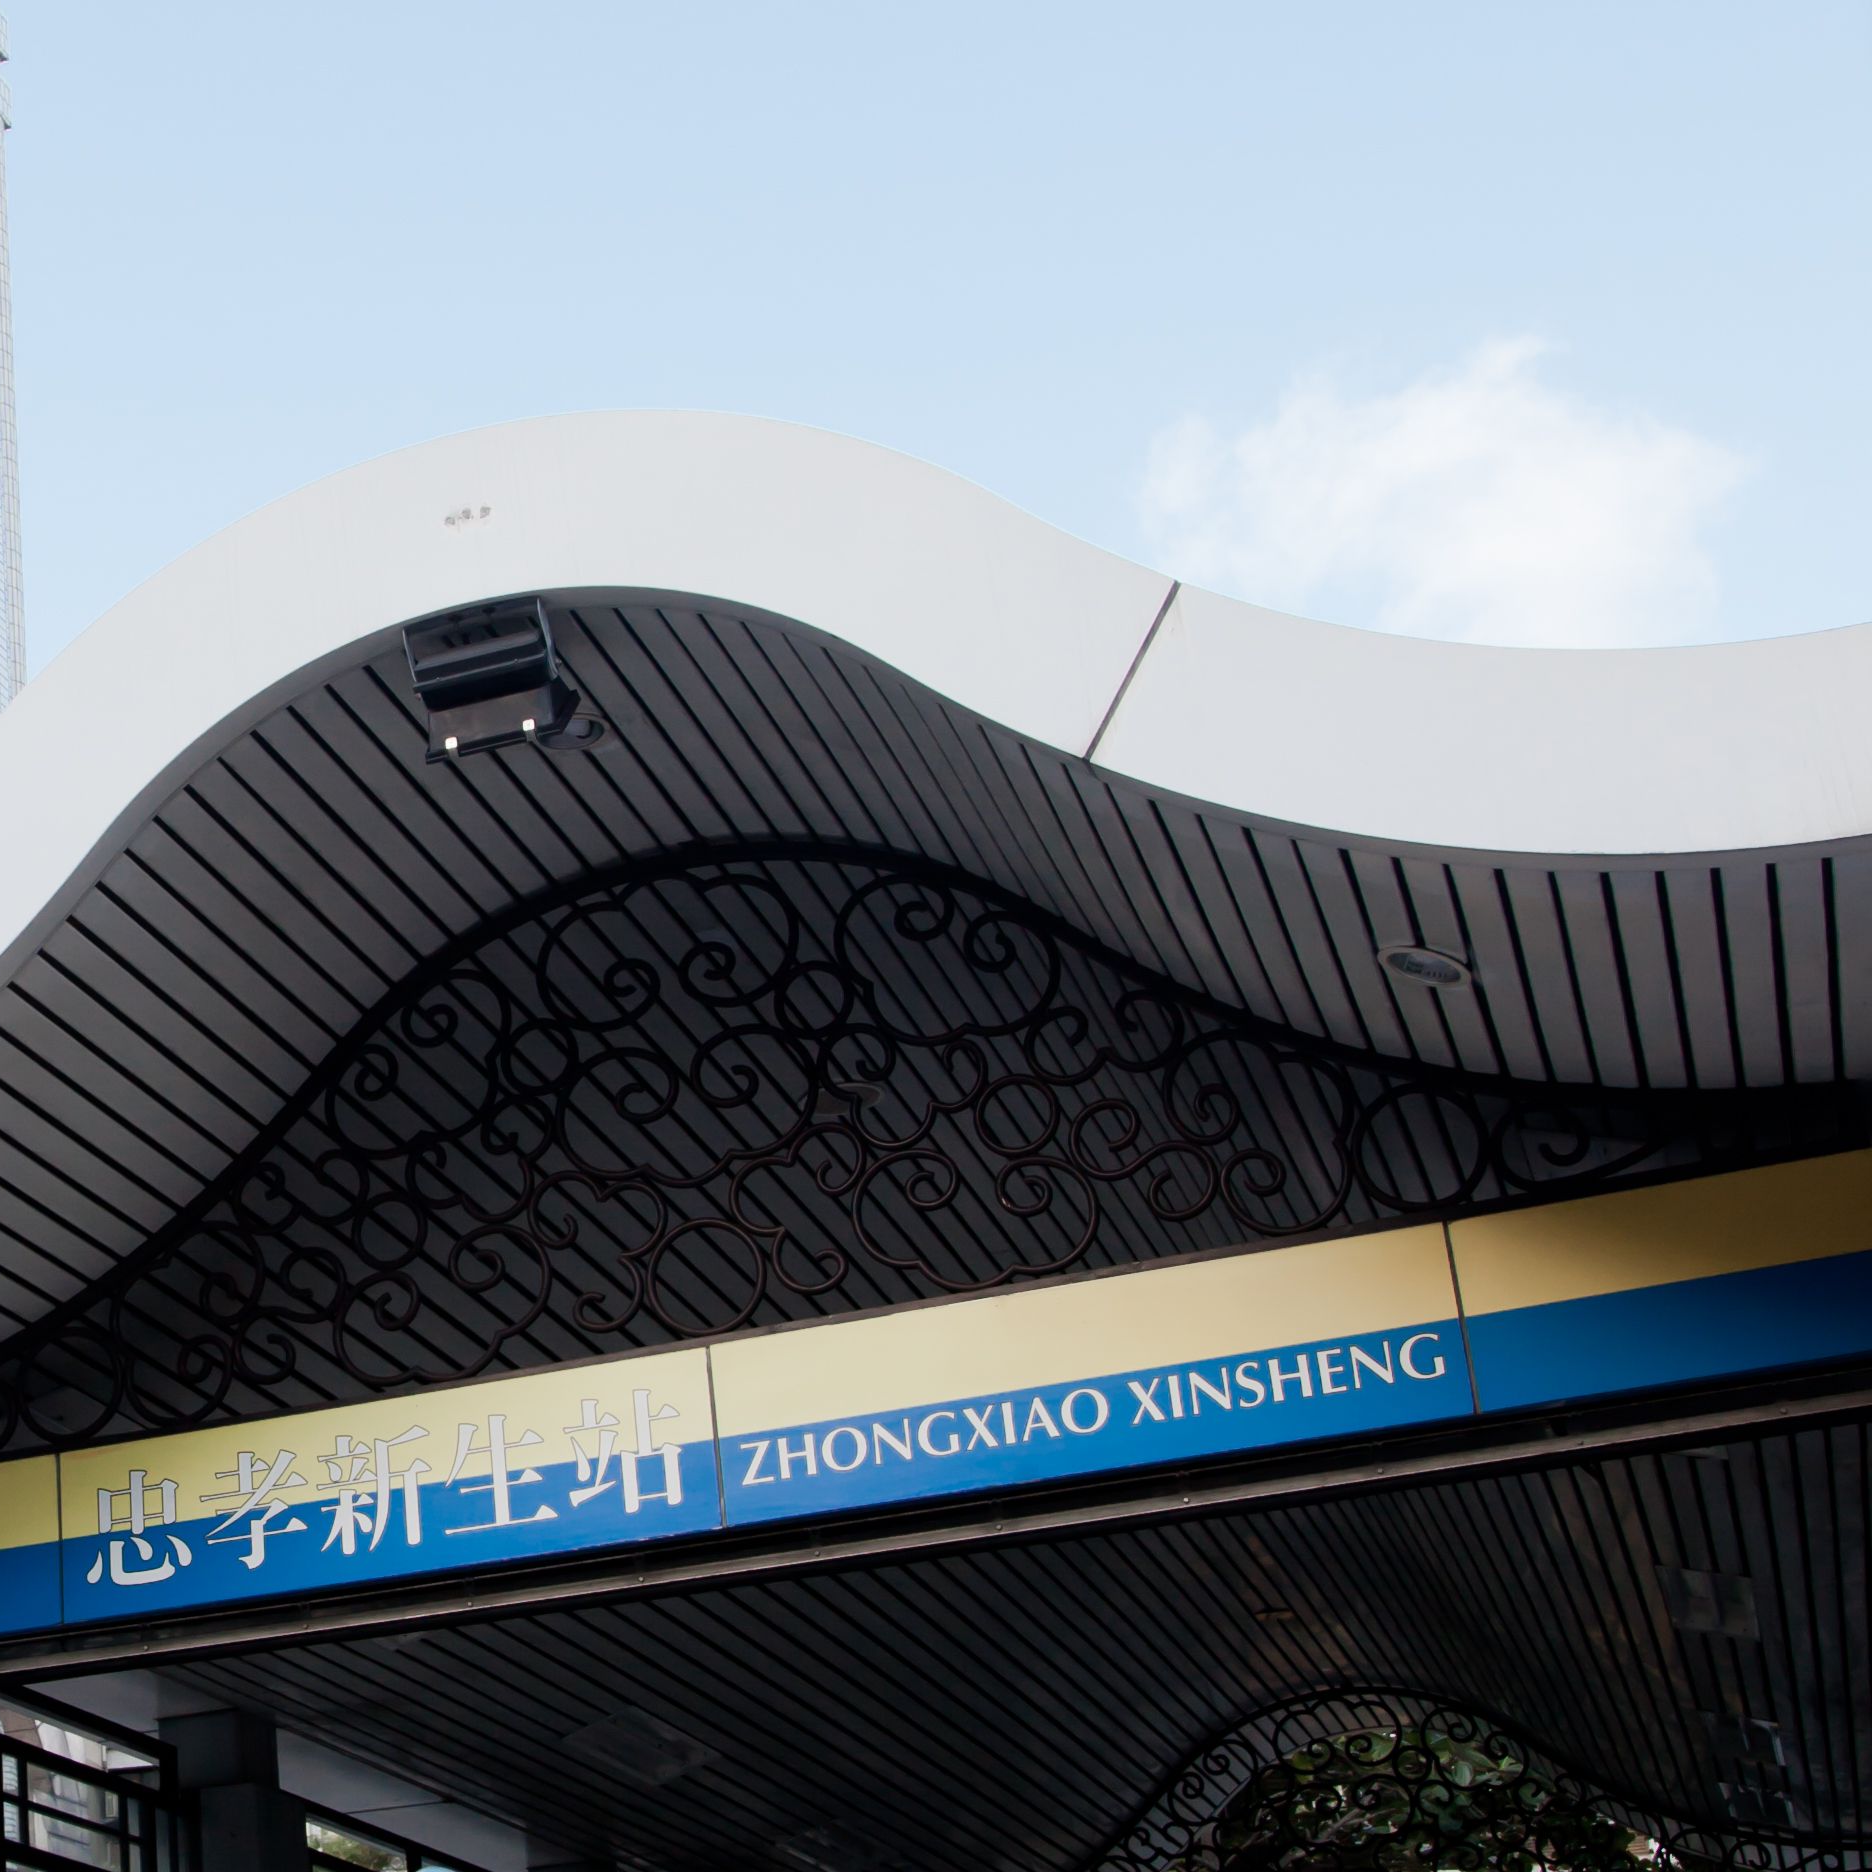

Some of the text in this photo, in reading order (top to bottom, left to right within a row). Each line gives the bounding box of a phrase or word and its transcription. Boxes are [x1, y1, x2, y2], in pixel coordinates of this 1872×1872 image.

[85, 1387, 684, 1588] 忠孝新生站
[740, 1331, 1450, 1487] ZHONGXIAO XINSHENG
